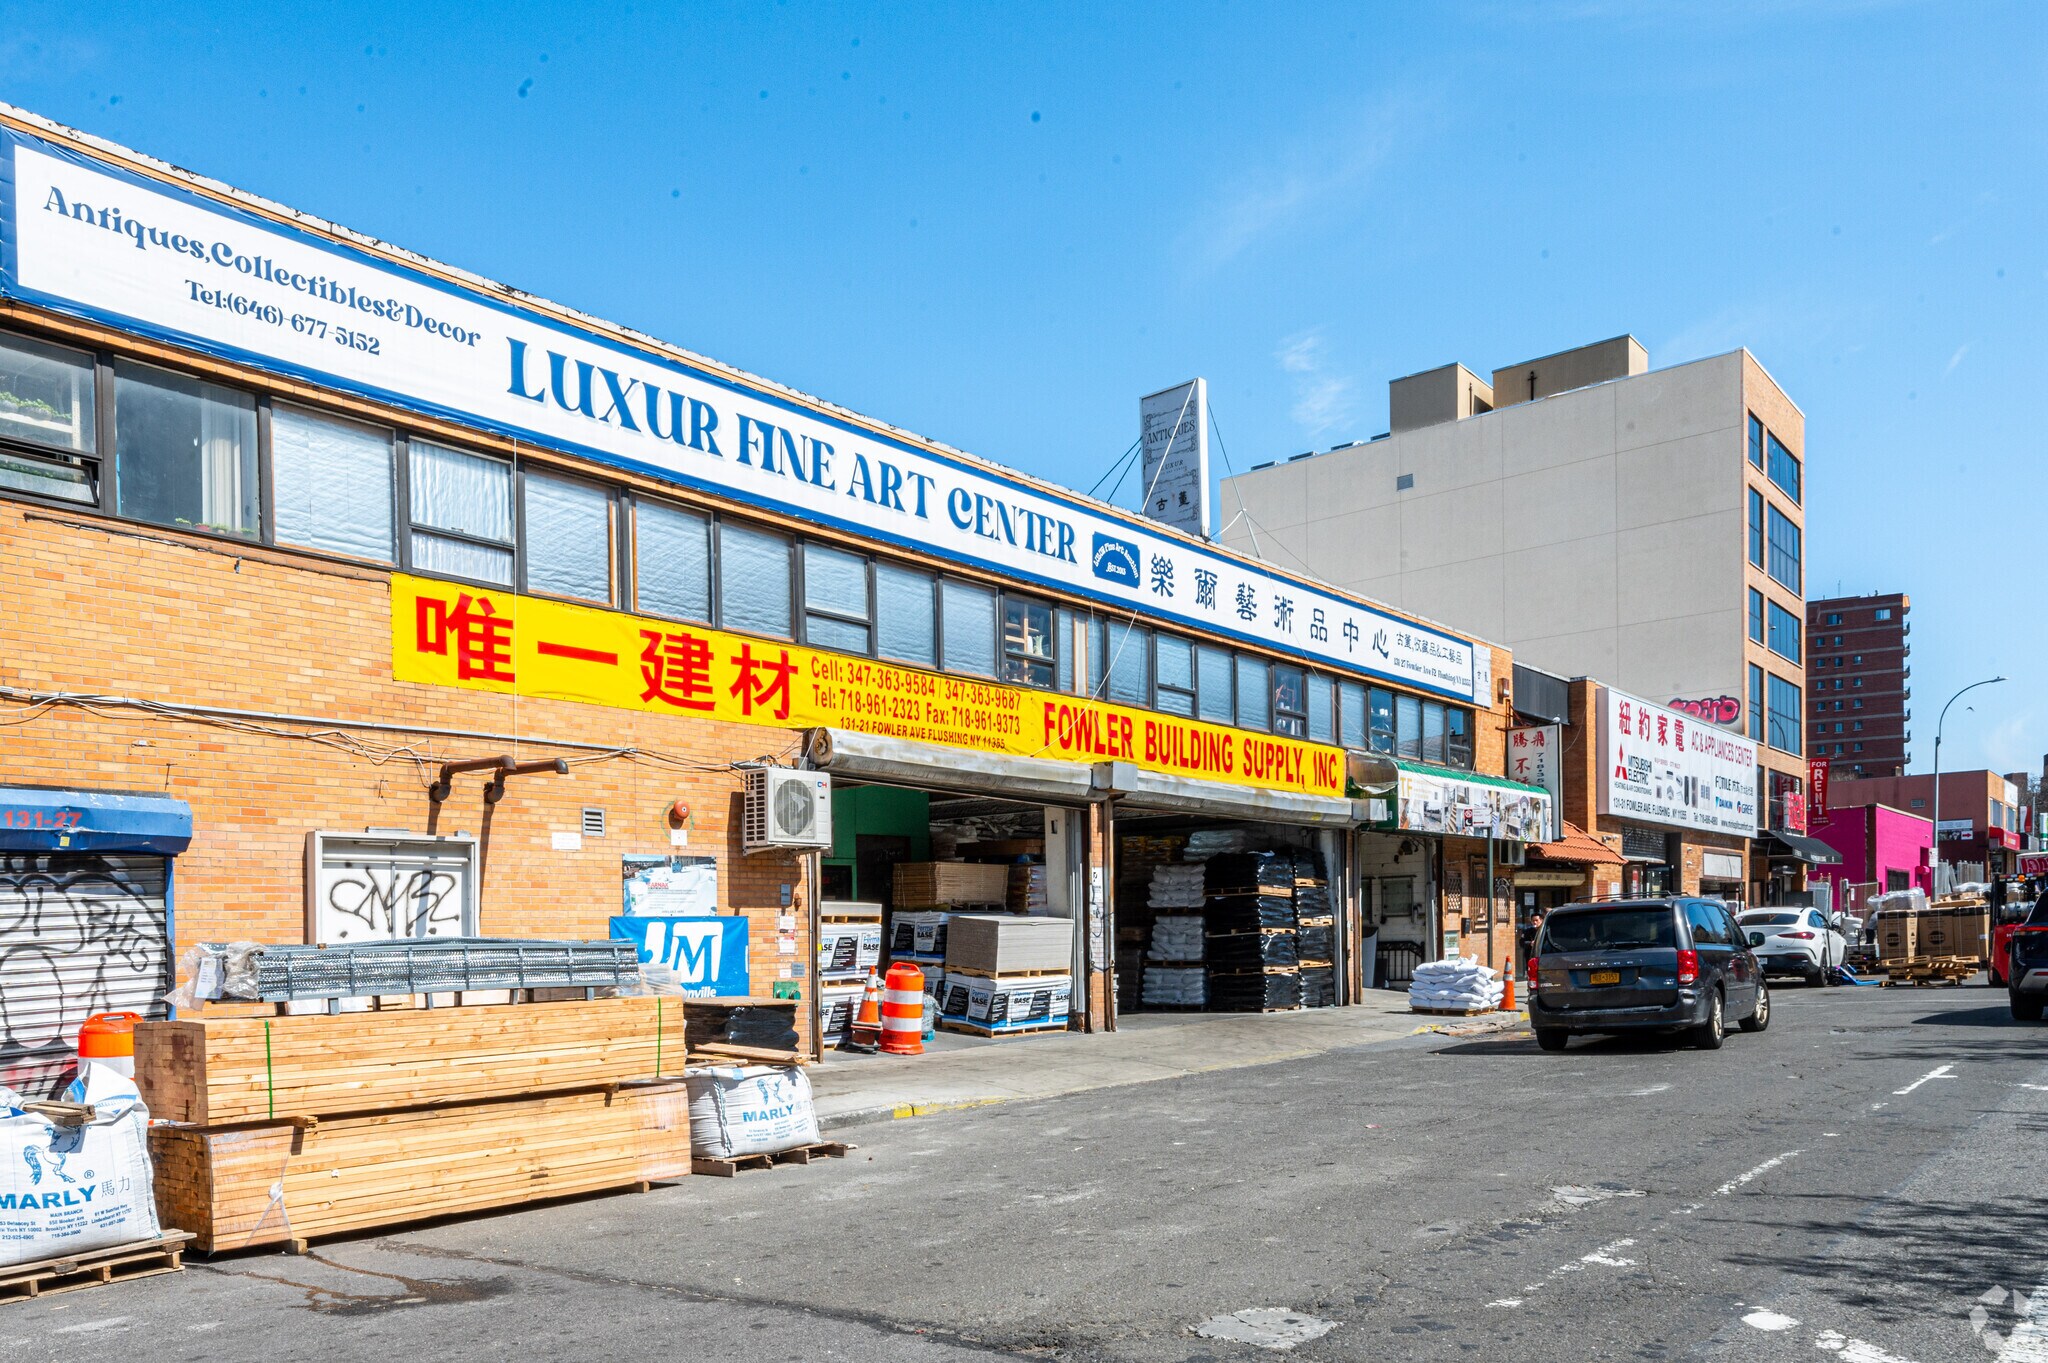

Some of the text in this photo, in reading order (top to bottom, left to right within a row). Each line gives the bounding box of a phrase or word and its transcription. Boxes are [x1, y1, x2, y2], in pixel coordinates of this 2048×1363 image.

[185, 280, 381, 356] Tel:(646)-677-5152
[1147, 420, 1195, 444] ANTIQUES
[507, 336, 1078, 565] LUXUR FINE ART CENTER
[415, 591, 798, 720] 唯一建材
[811, 656, 844, 682] Cell:
[847, 663, 935, 698] 347-363-9584
[945, 681, 1021, 711] 347-363-9687
[812, 684, 1021, 736] Tel: 718-961-2323 Fax: 718-961-9373
[840, 716, 870, 732] 131-21
[871, 721, 909, 738] FOWLER
[927, 729, 968, 745] FLUSHING
[970, 735, 982, 748] NY
[1619, 700, 1685, 752] 紐約家電
[1044, 702, 1338, 790] FOWLER BUILDING SUPPLY, INC
[1691, 730, 1699, 751] AC
[1704, 734, 1734, 762] APPLIANCES
[1735, 745, 1753, 768] CENTER
[1628, 754, 1652, 773] MITSUBISHI
[1628, 768, 1649, 785] ELECTRIC
[1719, 798, 1733, 810] DAIKIN
[1814, 769, 1824, 815] RENT
[1626, 799, 1643, 812] FOWLER
[1741, 803, 1753, 816] GREE
[3, 810, 83, 828] 131-27
[863, 943, 880, 951] BASE
[971, 996, 988, 1006] BASE
[1014, 997, 1031, 1005] BASE
[743, 1104, 794, 1123] MARLY
[0, 1184, 96, 1210] MARLY
[101, 1176, 130, 1198] 馬力
